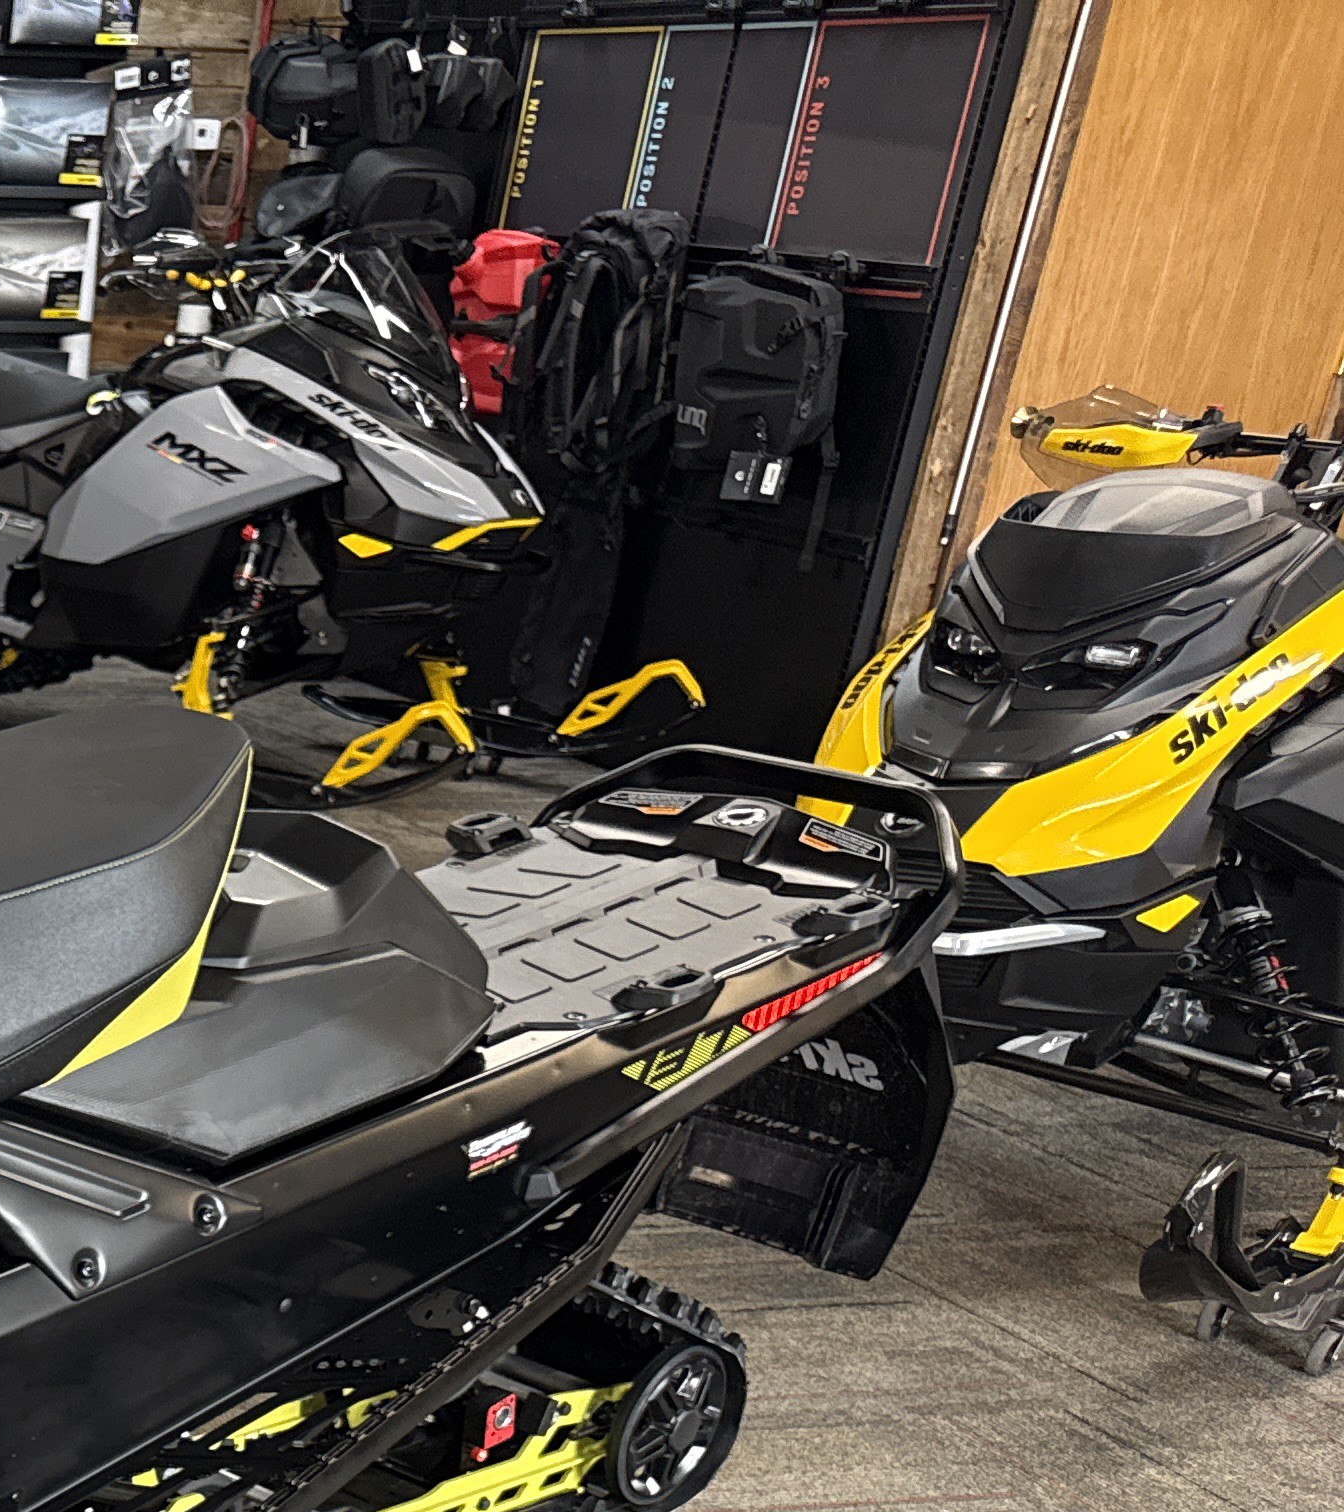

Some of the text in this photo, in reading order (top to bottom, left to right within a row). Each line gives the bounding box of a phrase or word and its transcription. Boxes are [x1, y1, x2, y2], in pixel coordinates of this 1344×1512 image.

[511, 79, 544, 198] POSITION 1
[636, 77, 675, 207] POSITION 2
[786, 75, 831, 216] POSITION 3
[152, 431, 249, 483] MXZ
[1062, 439, 1125, 455] ski-doo
